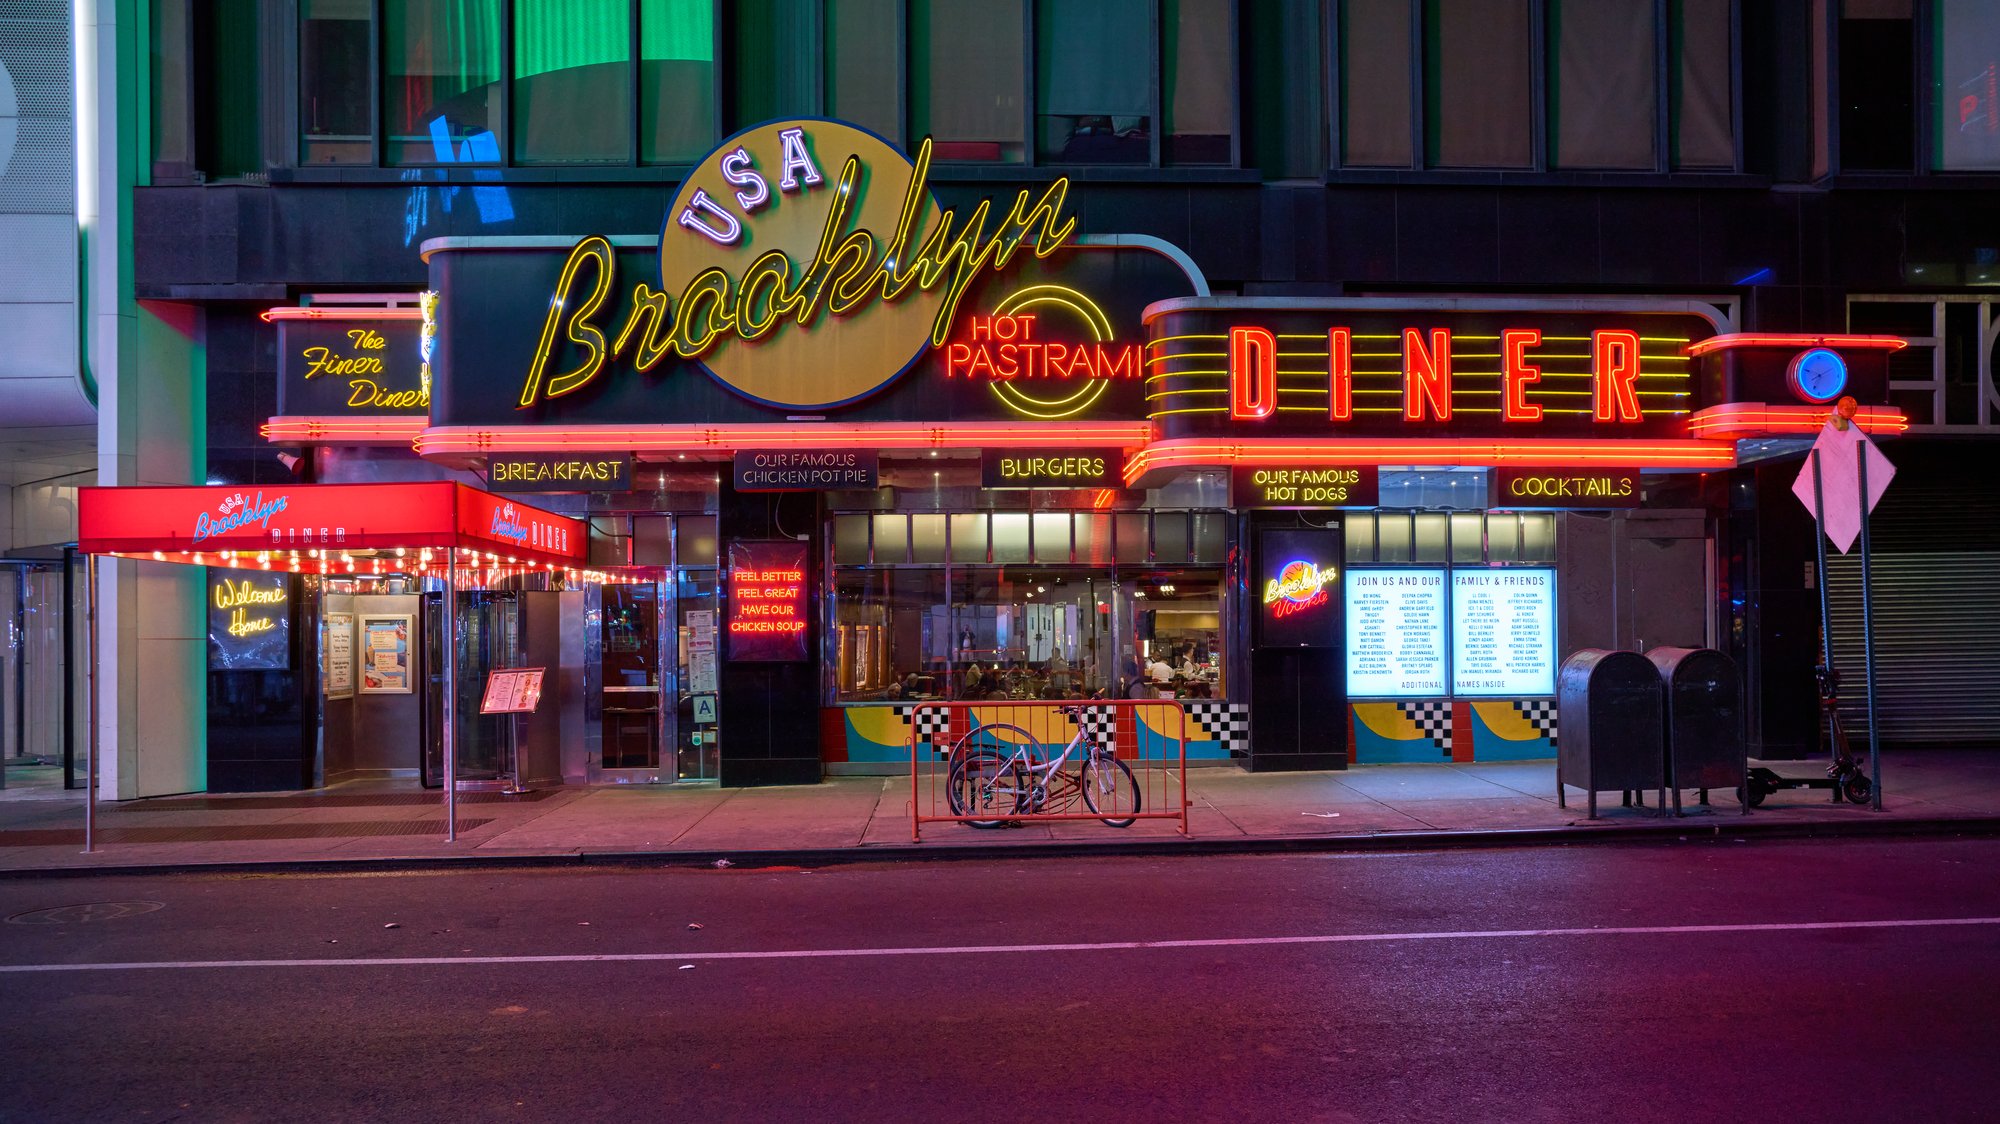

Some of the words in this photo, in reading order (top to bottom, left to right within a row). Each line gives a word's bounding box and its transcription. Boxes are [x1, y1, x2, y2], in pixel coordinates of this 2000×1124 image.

[677, 124, 825, 247] USA
[515, 134, 1079, 411] Brooklyn
[972, 315, 1036, 340] HOT
[347, 329, 386, 349] The
[303, 346, 384, 379] Finer
[948, 343, 1143, 377] PASTRAMI
[1229, 326, 1644, 422] DINER
[347, 379, 430, 408] Diner
[754, 453, 788, 468] OUR
[790, 453, 856, 467] FAMOUS
[1000, 457, 1106, 478] BURGERS
[493, 461, 623, 482] BREAKFAST
[743, 470, 808, 484] CHICKEN
[810, 470, 841, 484] POT
[844, 470, 868, 483] PIE
[1255, 470, 1289, 485] OUR
[1292, 470, 1360, 485] FAMOUS
[1266, 487, 1298, 501] HOT
[1303, 487, 1348, 501] DOGS
[1511, 477, 1632, 497] COCKTAILS
[218, 493, 244, 515] USA
[192, 491, 288, 544] Brooklyn
[491, 506, 528, 547] Brooklyn
[272, 528, 345, 543] DINER
[532, 521, 567, 551] DINER
[735, 572, 760, 581] FEEL
[762, 571, 801, 581] BETTER
[1264, 563, 1336, 603] Brooklyn
[1357, 577, 1378, 586] JOIN
[1382, 577, 1394, 586] US
[1398, 577, 1417, 586] AND
[1421, 577, 1441, 586] OUR
[1455, 577, 1490, 586] FAMILY
[1494, 577, 1500, 586] &
[1504, 577, 1545, 586] FRIENDS
[216, 578, 287, 608] Welcome
[737, 588, 763, 598] FEEL
[764, 588, 798, 598] GREAT
[741, 604, 769, 615] HAVE
[771, 605, 794, 615] OUR
[228, 607, 276, 636] Home
[731, 622, 774, 632] CHICKEN
[776, 622, 804, 632] SOUP
[699, 700, 711, 714] A
